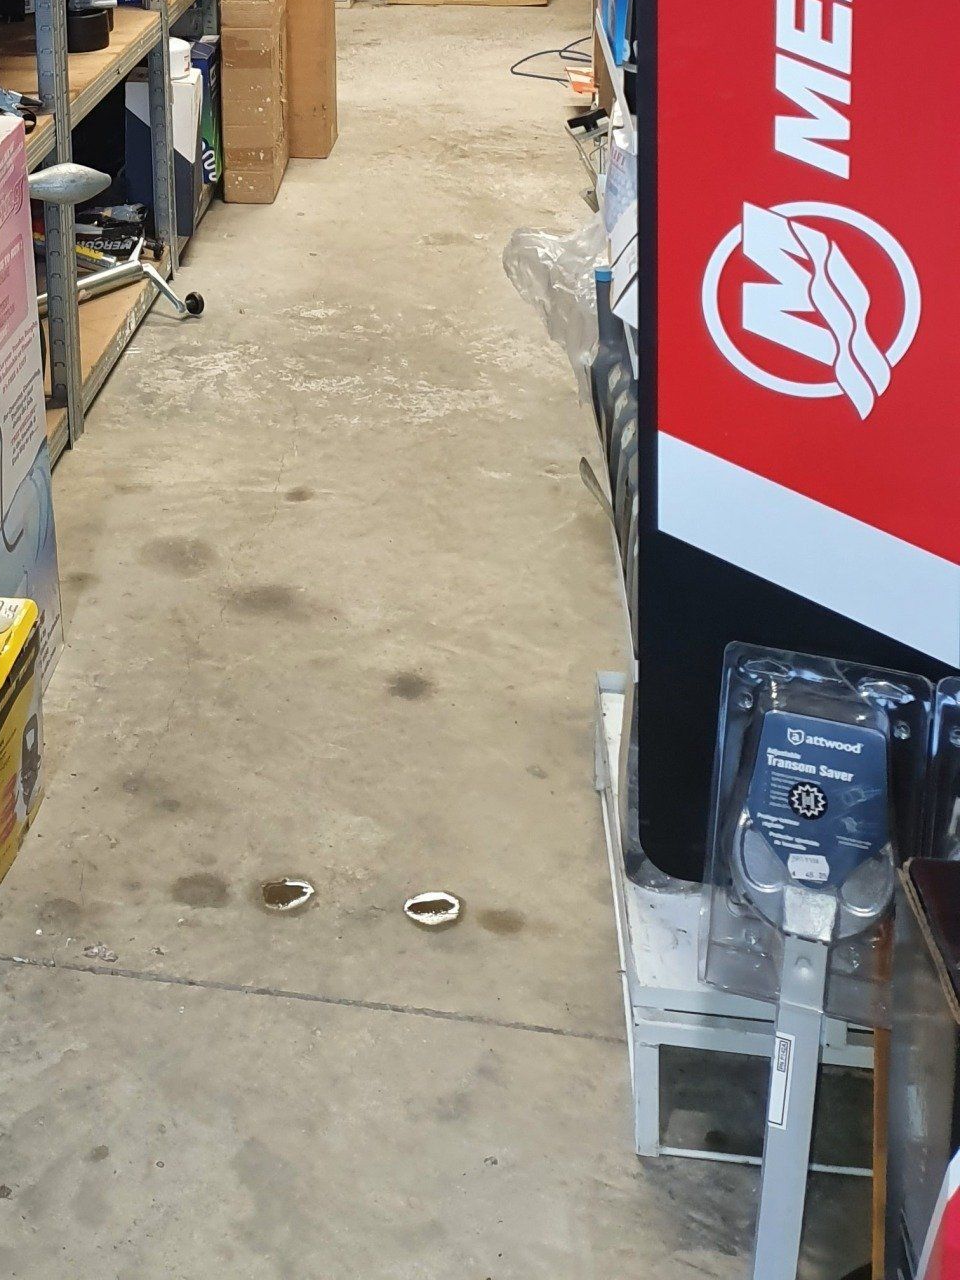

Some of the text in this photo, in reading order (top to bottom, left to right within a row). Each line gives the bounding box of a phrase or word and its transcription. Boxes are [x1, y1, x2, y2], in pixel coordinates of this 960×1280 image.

[805, 735, 862, 754] attwood
[767, 754, 855, 782] Transom Saver
